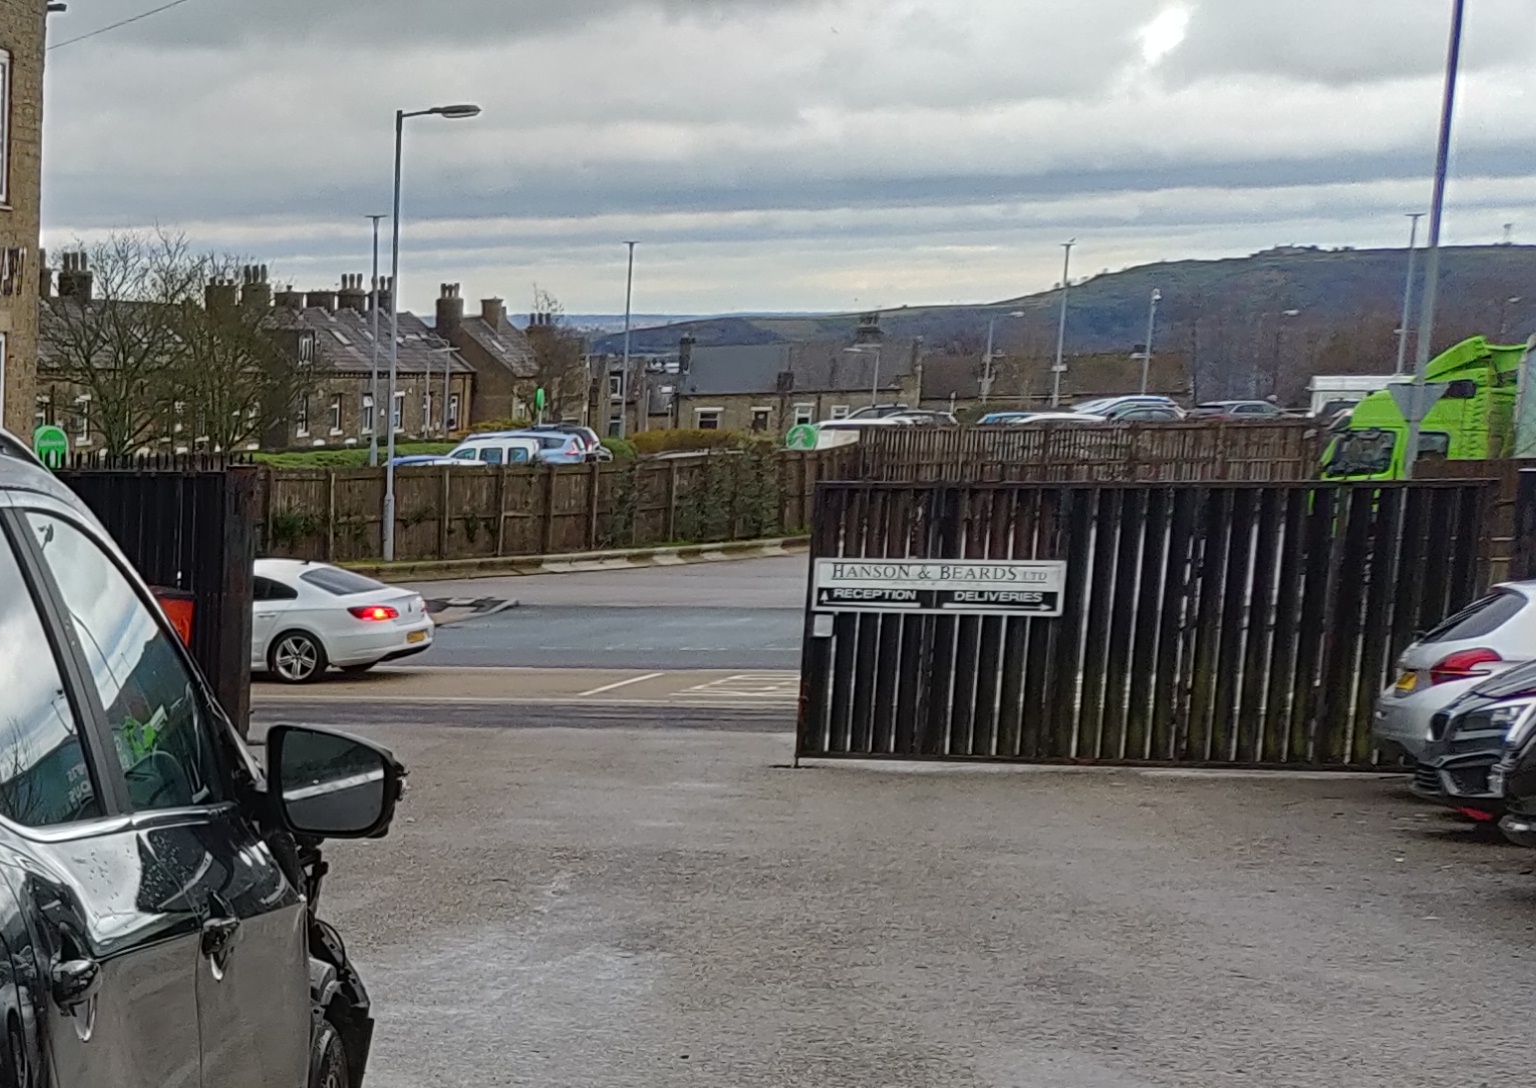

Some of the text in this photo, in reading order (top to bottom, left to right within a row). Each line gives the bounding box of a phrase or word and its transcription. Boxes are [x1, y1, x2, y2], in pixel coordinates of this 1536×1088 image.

[832, 563, 1048, 582] HANSON & BEARDS LTD
[833, 588, 1043, 603] RECEPTION DELIVERIES
